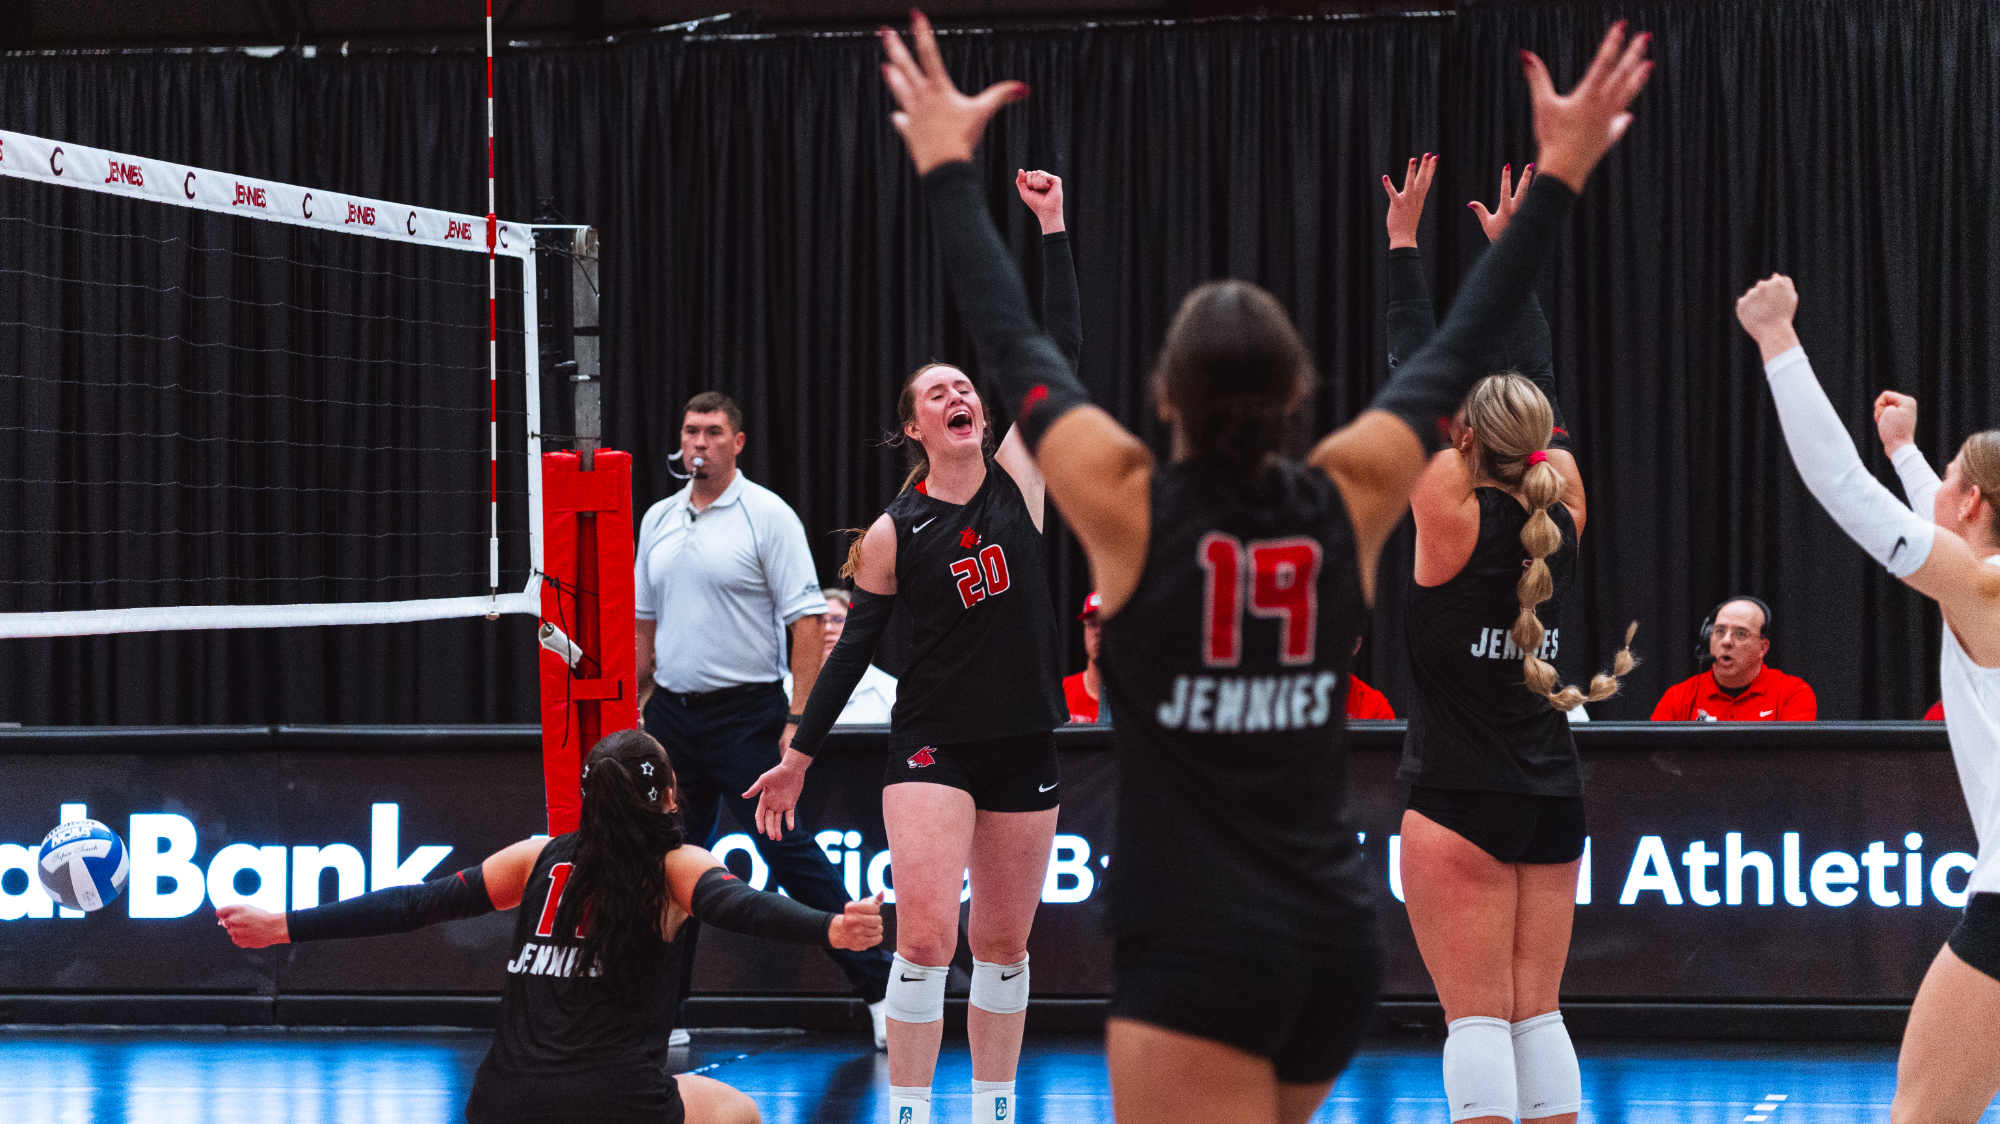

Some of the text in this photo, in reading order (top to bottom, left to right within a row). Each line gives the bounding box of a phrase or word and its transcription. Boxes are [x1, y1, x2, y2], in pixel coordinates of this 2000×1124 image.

[50, 146, 64, 176] C
[105, 158, 144, 186] JENNIES
[184, 171, 196, 199] C
[232, 181, 267, 208] JENNIES
[302, 193, 313, 219] C
[344, 201, 376, 226] JENNIES
[407, 211, 416, 235] C
[444, 218, 472, 240] JENNIES
[950, 544, 1011, 609] 20
[1198, 533, 1322, 666] 19
[1471, 627, 1559, 660] JENES
[1158, 671, 1336, 731] JENNIES
[51, 826, 92, 849] NCAA
[129, 803, 453, 919] Bank
[1618, 831, 1977, 908] Athletic
